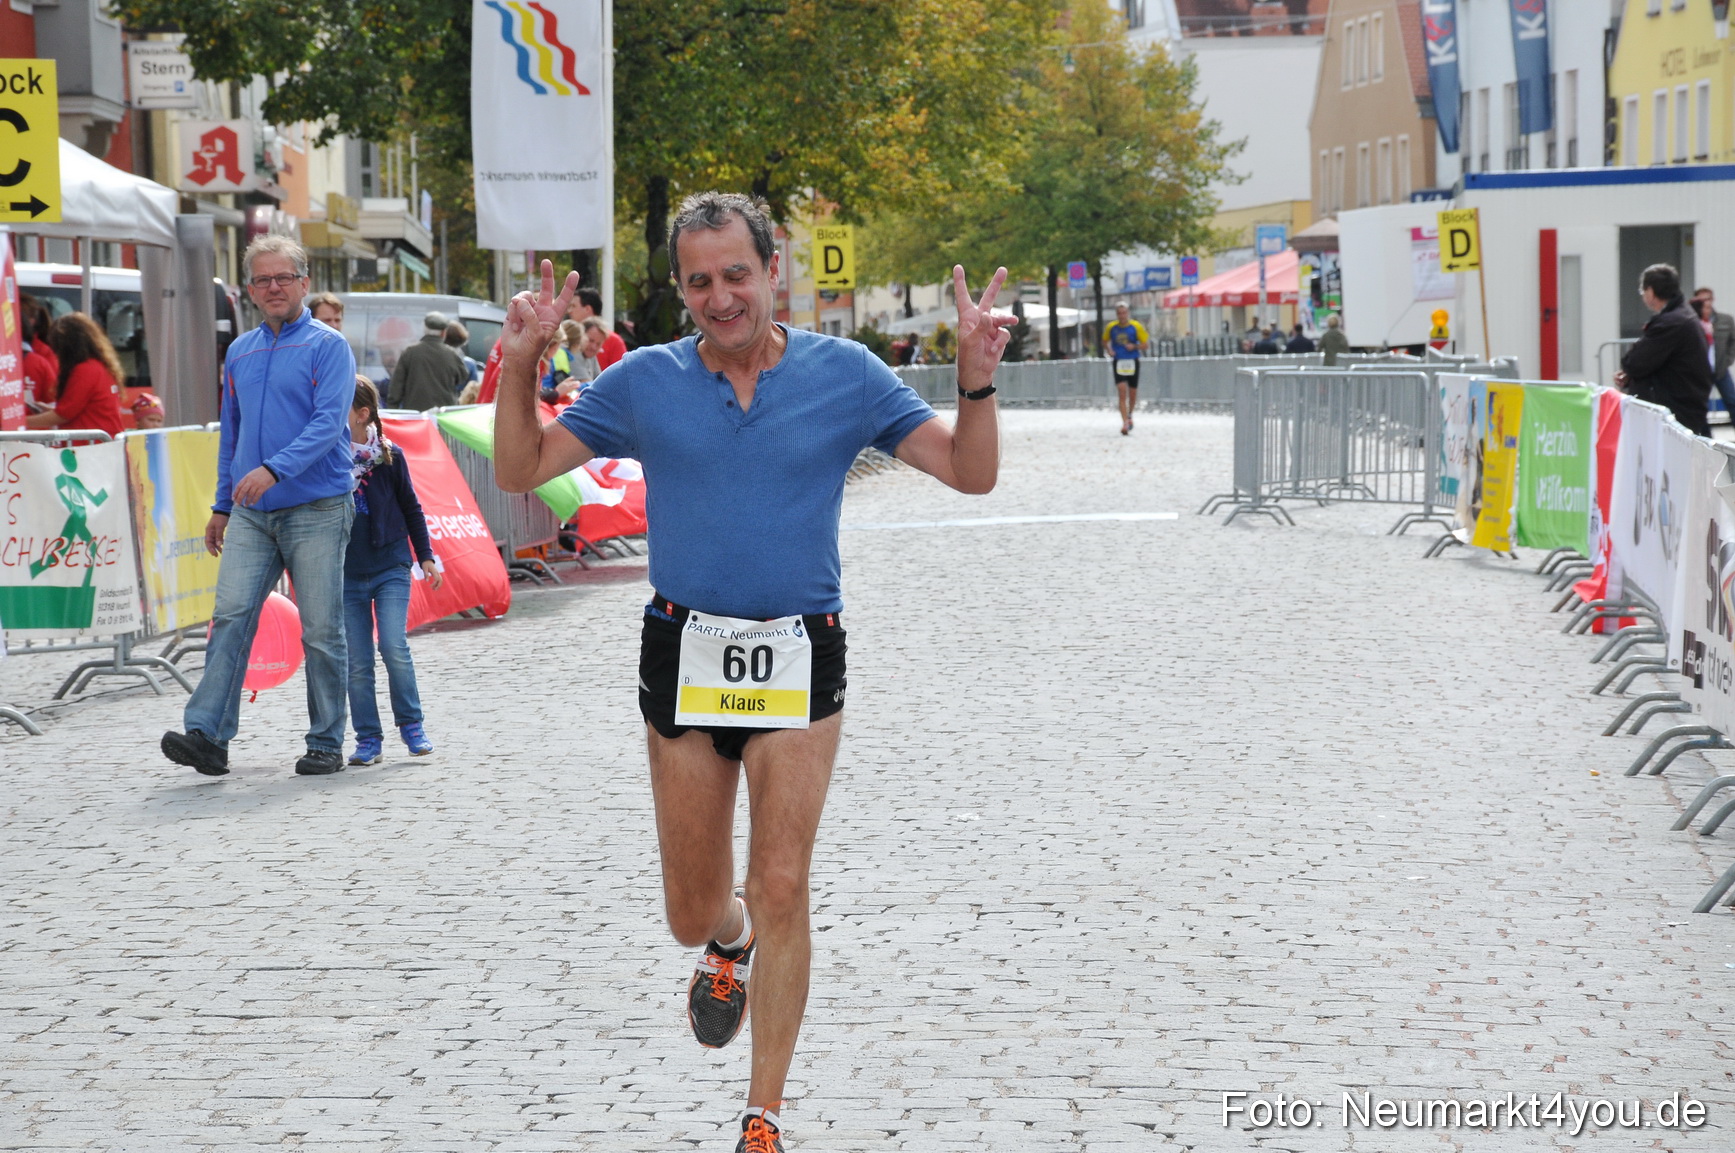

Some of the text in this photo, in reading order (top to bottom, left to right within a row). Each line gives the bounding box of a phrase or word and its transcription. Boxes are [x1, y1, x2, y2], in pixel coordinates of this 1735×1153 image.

[141, 61, 186, 75] Stern
[1441, 211, 1476, 224] Block
[817, 228, 848, 240] Block
[1450, 228, 1471, 258] D
[824, 245, 844, 274] D
[0, 489, 22, 525] S
[687, 622, 789, 640] PARTL Neumarkt
[722, 645, 773, 683] 60
[684, 676, 690, 685] D
[720, 693, 766, 711] Klaus
